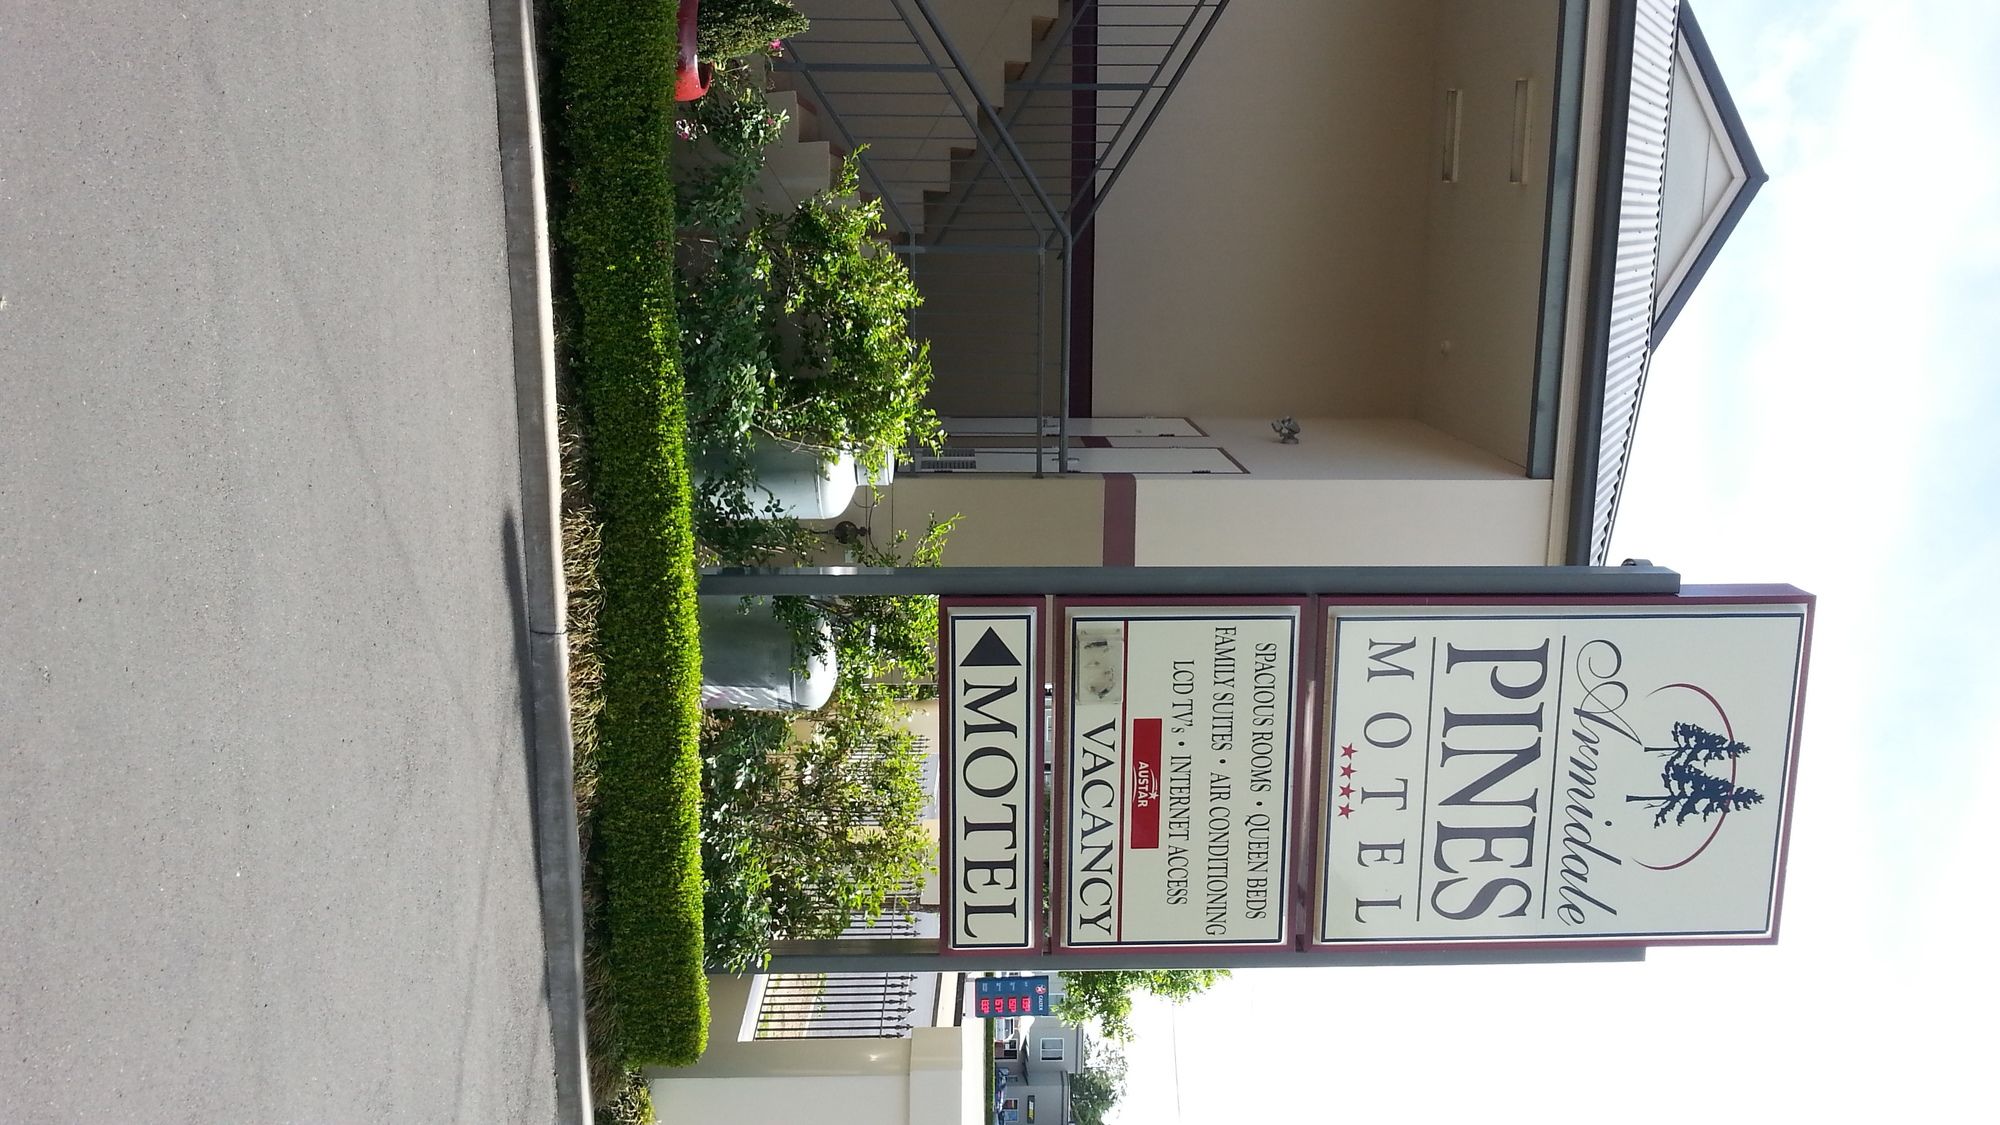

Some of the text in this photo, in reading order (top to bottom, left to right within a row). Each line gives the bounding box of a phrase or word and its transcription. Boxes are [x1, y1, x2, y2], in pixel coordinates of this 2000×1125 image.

[962, 675, 1019, 939] MOTEL
[1079, 717, 1117, 936] VACANCY
[1135, 760, 1150, 808] AUSTAR
[1166, 659, 1195, 905] LCD TV's INTERNET ACCESS
[1205, 626, 1237, 936] FAMILY SUITES AIR CONDITIONING
[1244, 642, 1278, 920] SPACIOUS ROOMS QUEEN BEDS
[1354, 636, 1417, 924] MOTEL
[1430, 637, 1550, 921] PINES
[1556, 639, 1643, 926] Armidale
